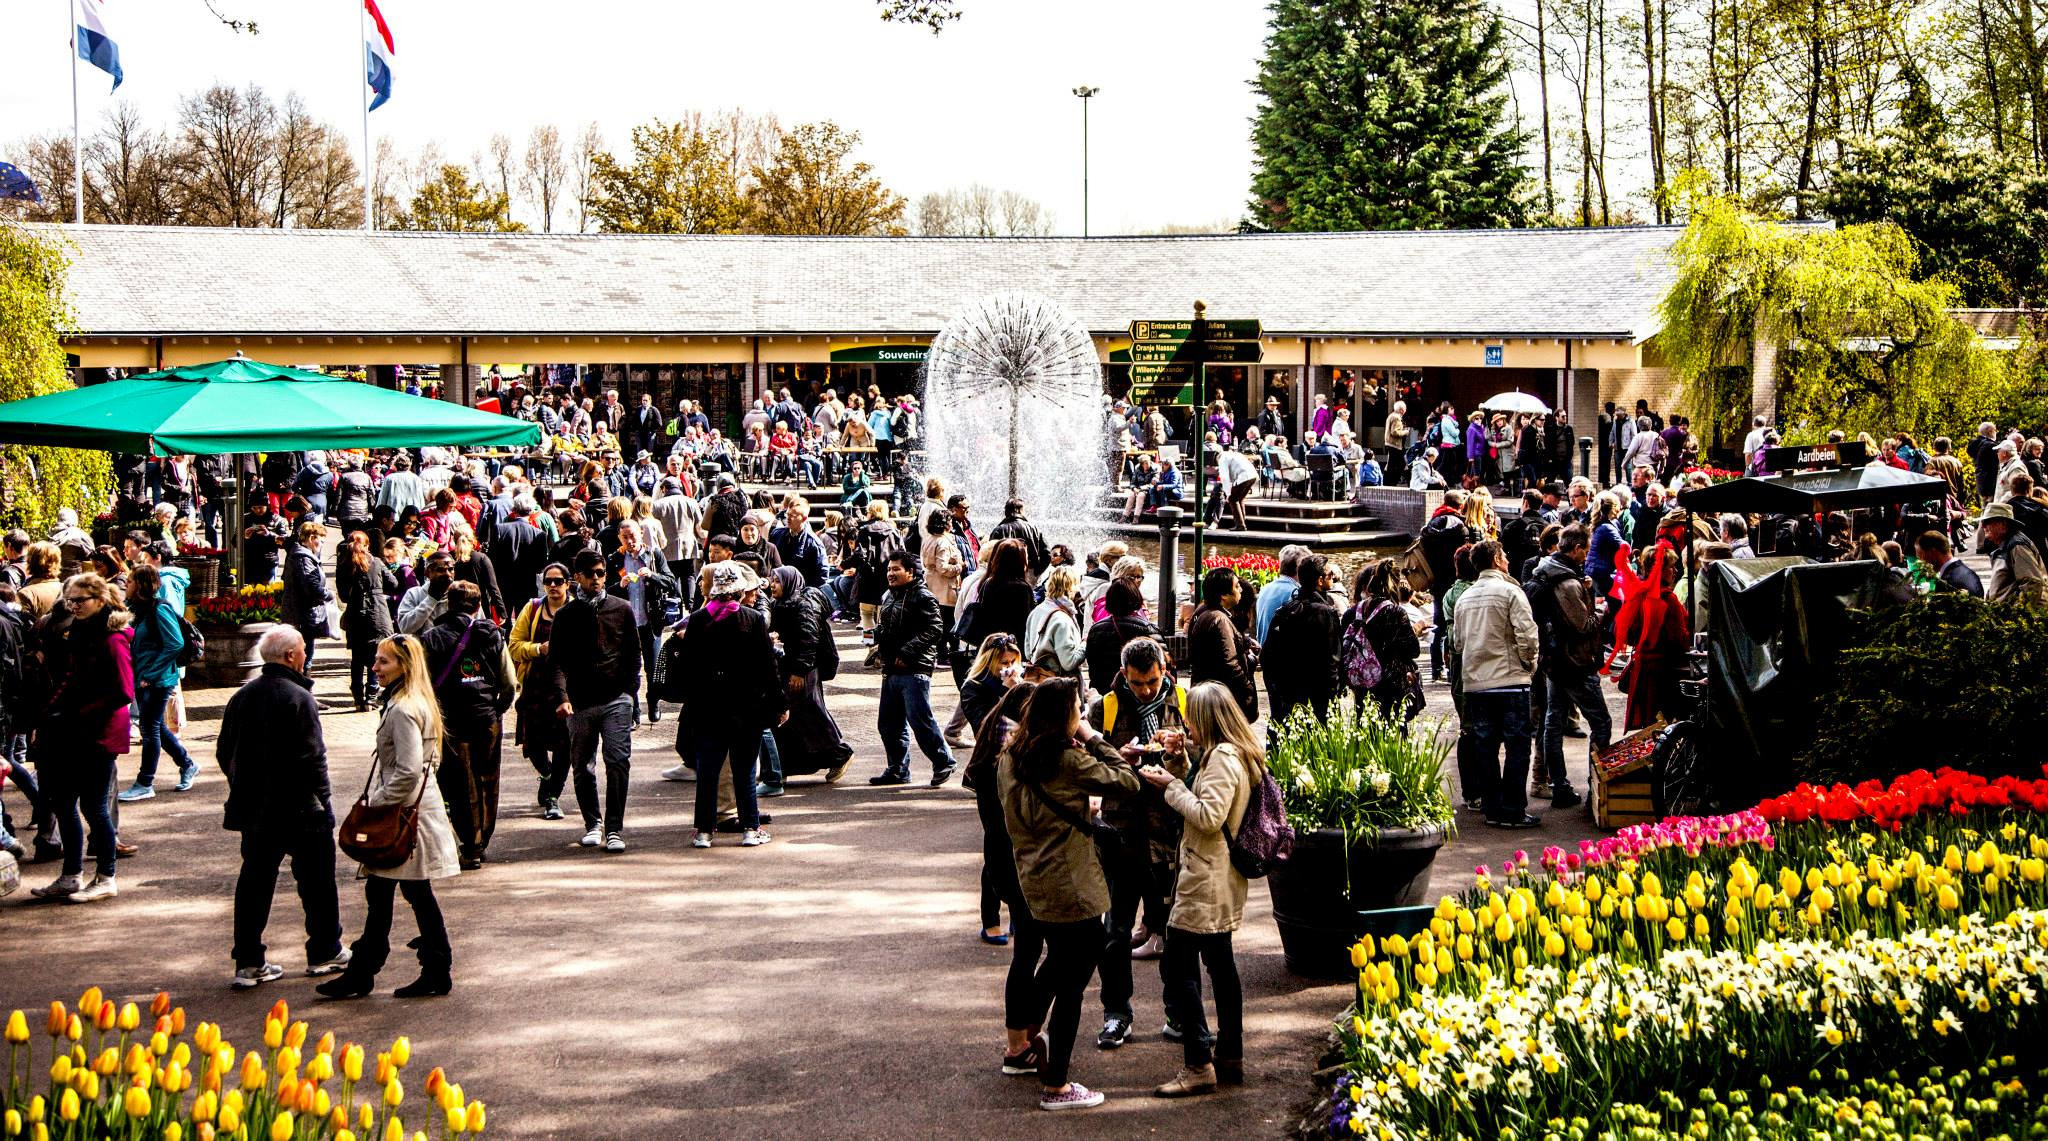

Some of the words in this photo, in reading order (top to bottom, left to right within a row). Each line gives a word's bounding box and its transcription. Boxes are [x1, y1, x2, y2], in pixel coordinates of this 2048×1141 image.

[1151, 322, 1175, 330] Entrance
[1177, 322, 1191, 330] Extra
[1135, 344, 1155, 353] Oranje
[1156, 344, 1177, 352] Nassau
[878, 350, 929, 360] Souvenirs
[1797, 448, 1836, 463] Aardbeien
